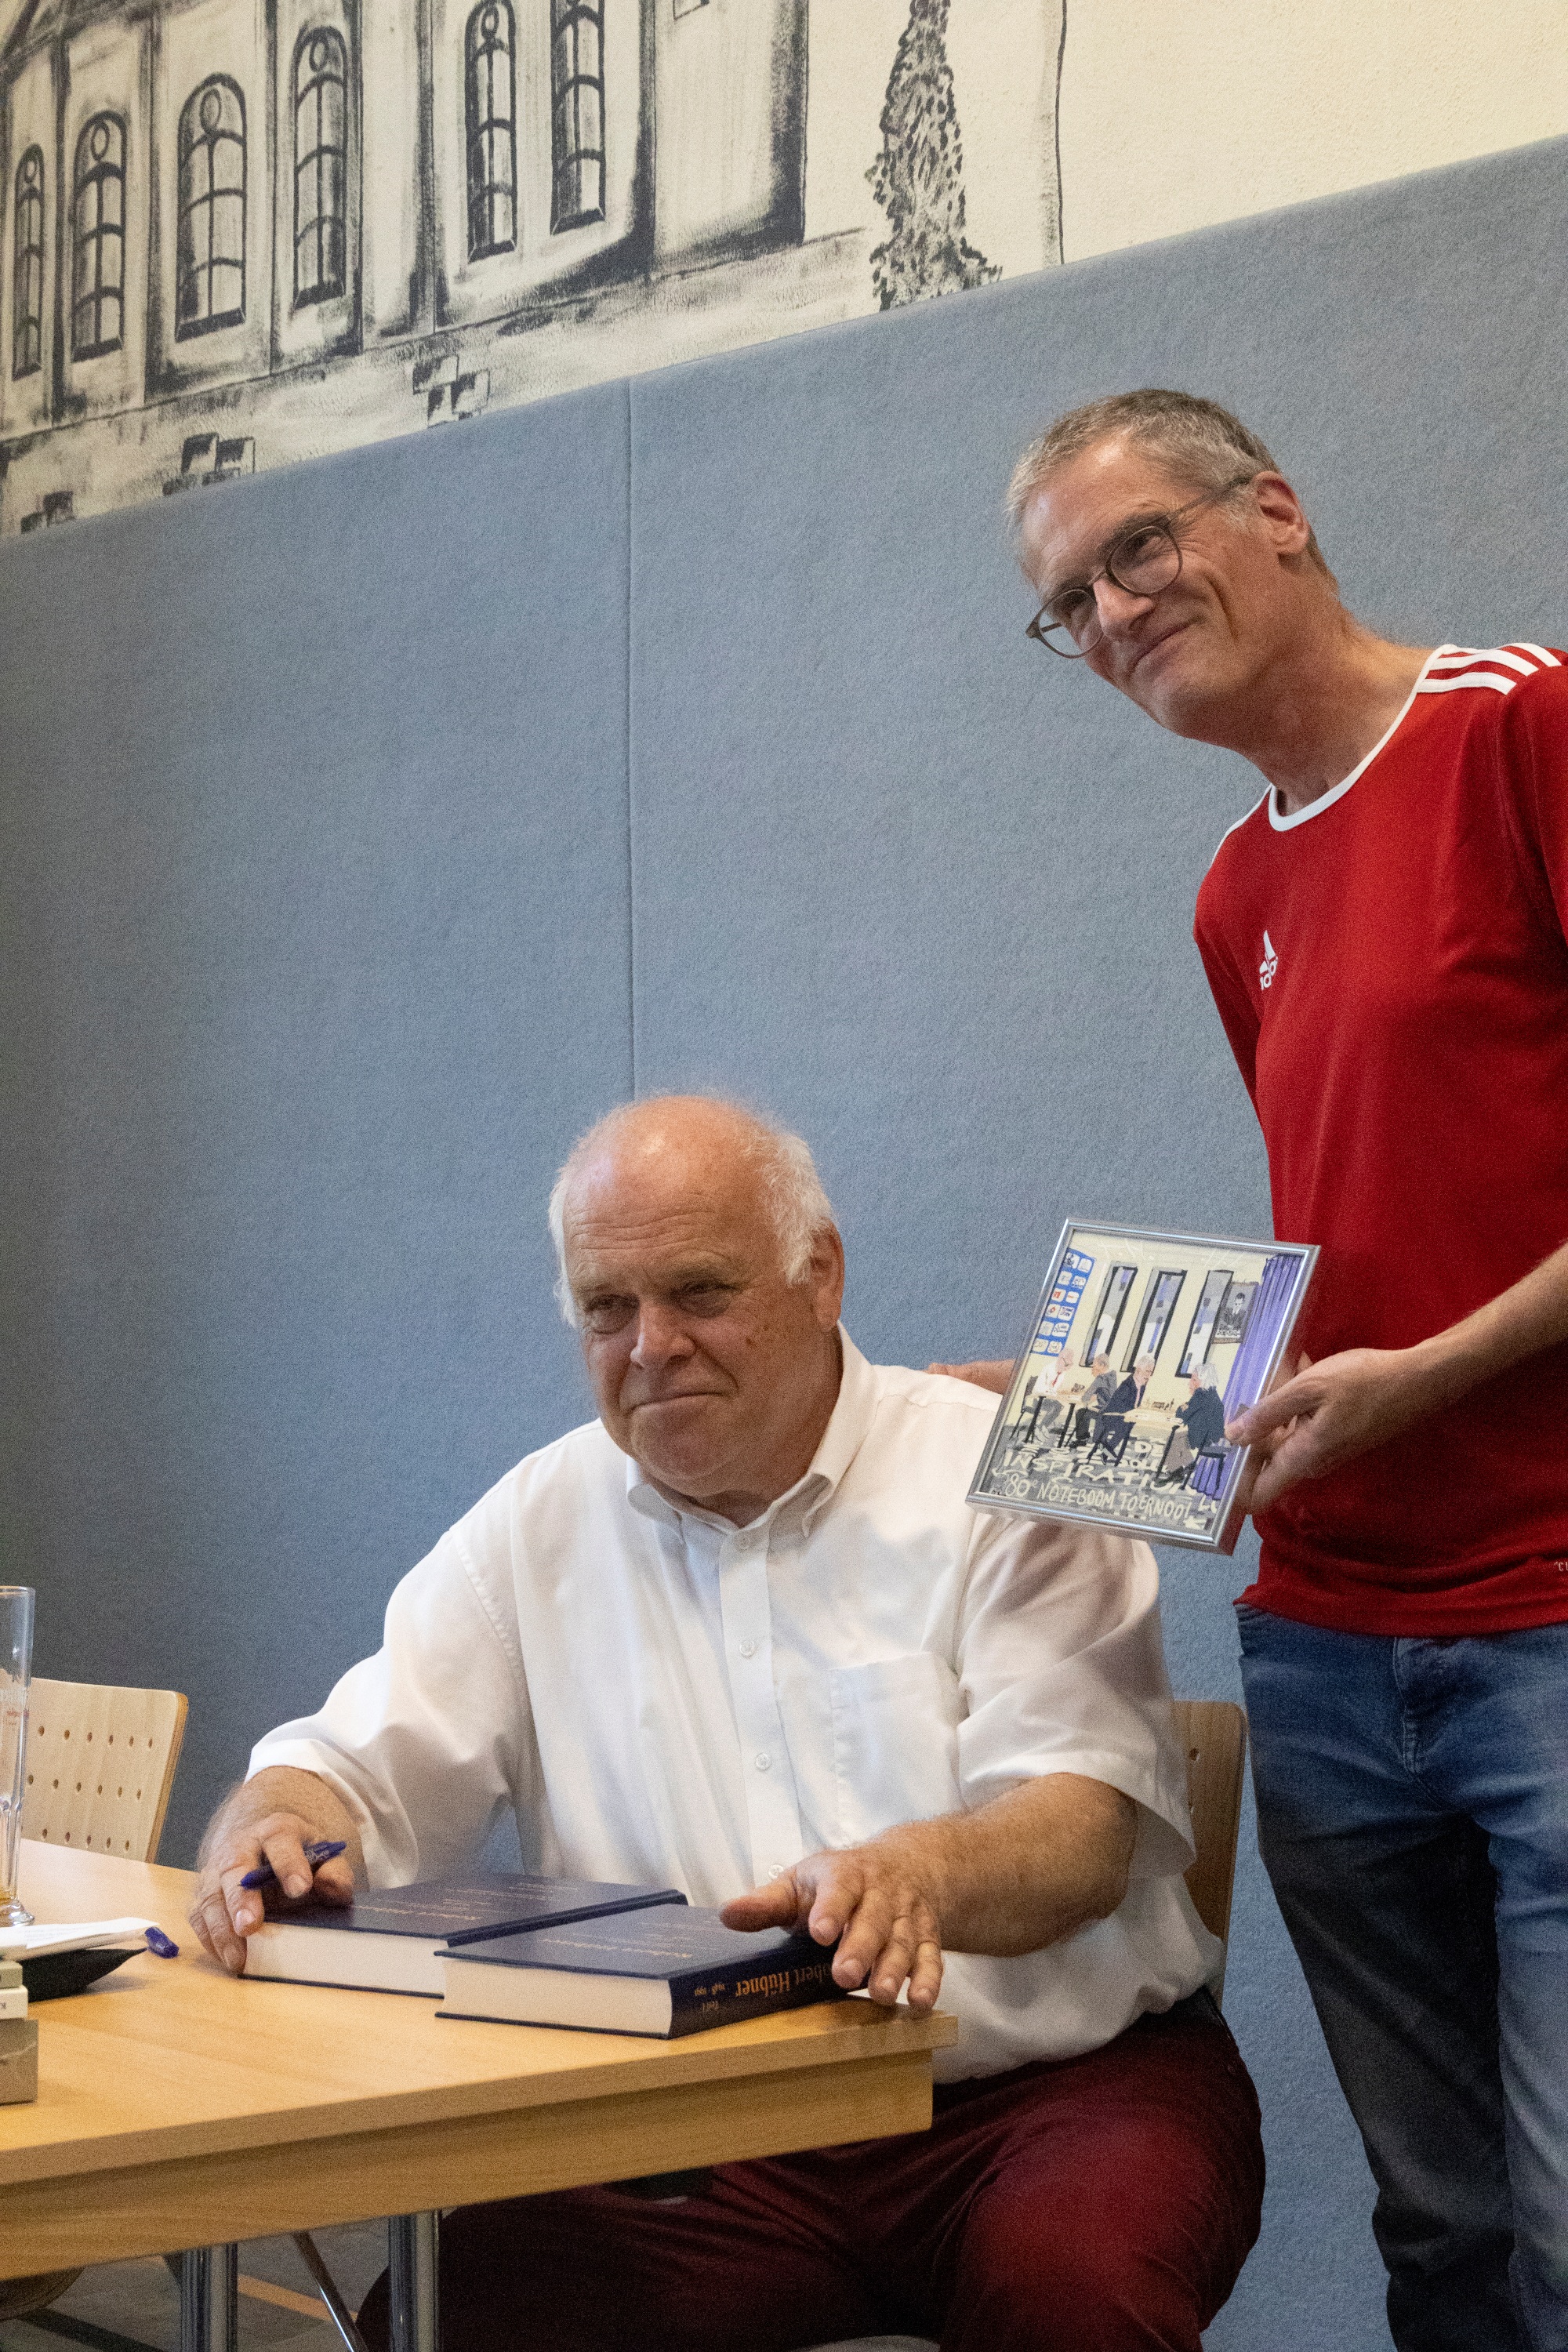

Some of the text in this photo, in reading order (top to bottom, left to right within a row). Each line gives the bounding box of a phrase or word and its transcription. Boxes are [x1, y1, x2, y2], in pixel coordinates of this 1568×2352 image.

[1036, 1480, 1116, 1509] NOTEBOOM
[1119, 1491, 1192, 1519] TOERNOOI
[735, 1962, 834, 1998] obert Hübner
